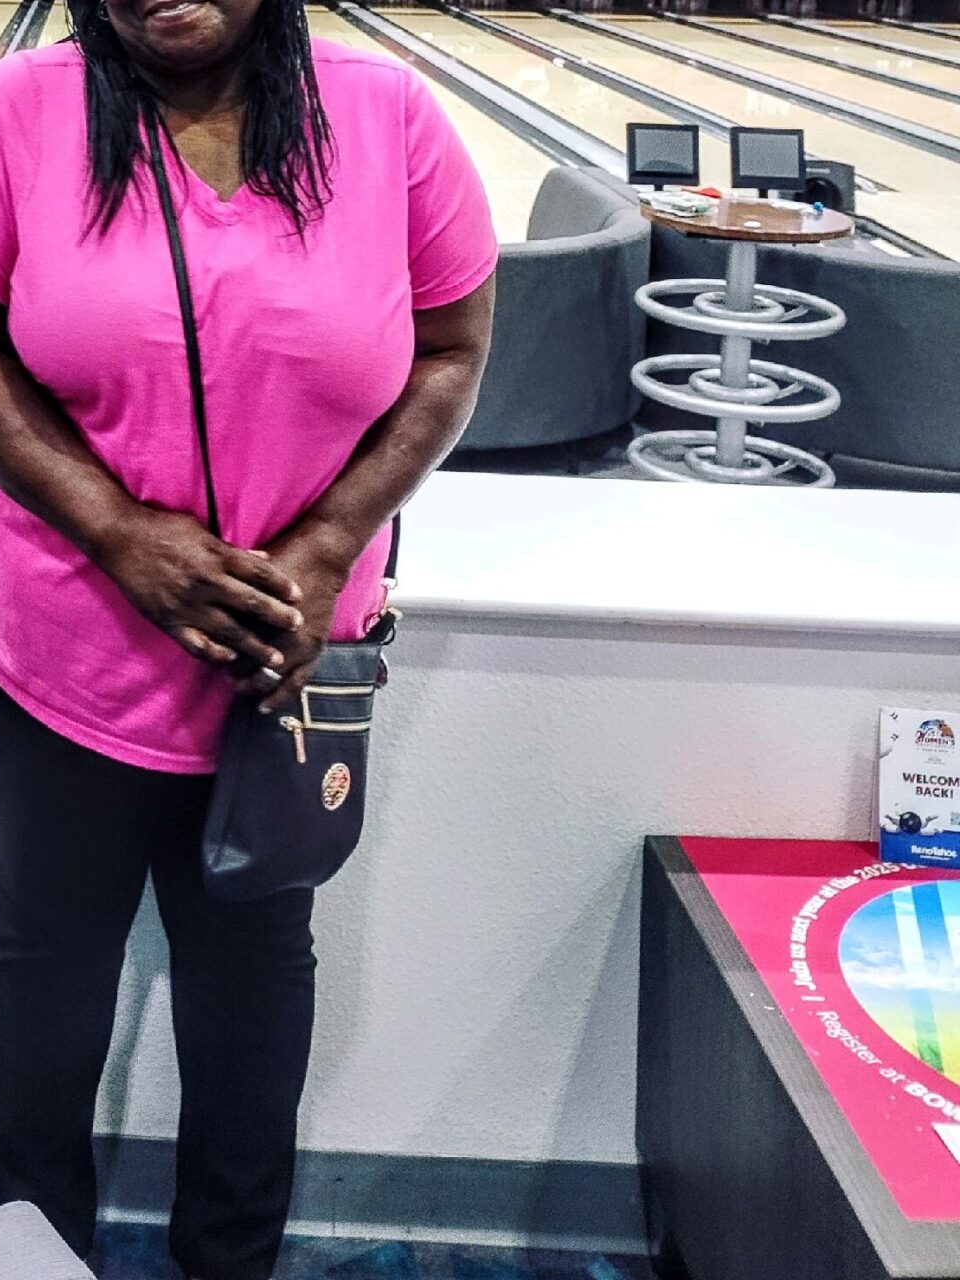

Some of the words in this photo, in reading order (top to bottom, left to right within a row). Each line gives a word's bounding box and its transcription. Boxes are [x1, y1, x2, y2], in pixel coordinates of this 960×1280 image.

[916, 786, 954, 798] BACK!
[853, 862, 901, 880] 2025
[828, 876, 860, 891] the
[799, 895, 827, 920] year
[789, 960, 816, 991] Join
[816, 1010, 882, 1065] Register
[879, 1068, 907, 1084] at
